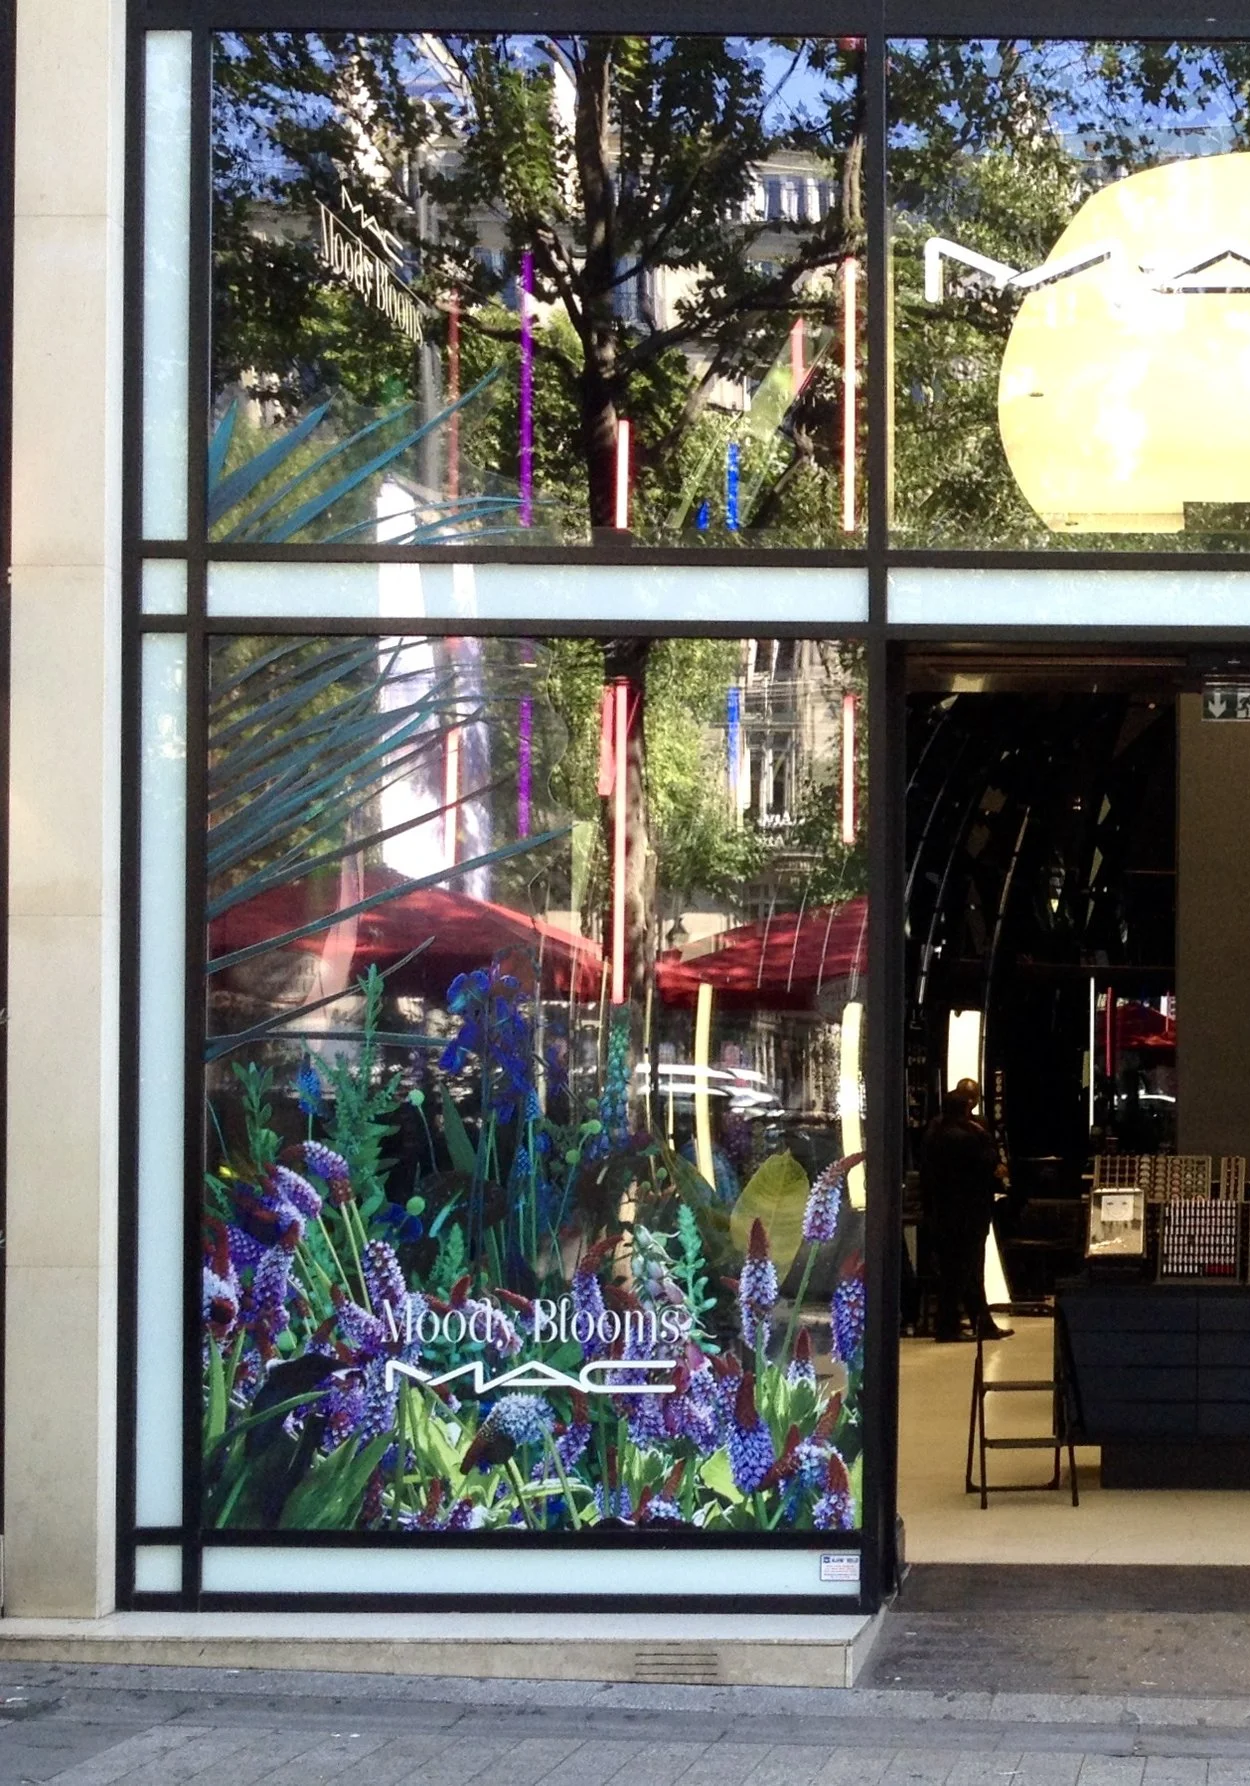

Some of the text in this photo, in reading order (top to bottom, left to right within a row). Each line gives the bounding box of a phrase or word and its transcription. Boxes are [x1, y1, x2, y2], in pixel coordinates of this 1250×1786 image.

[380, 1293, 686, 1349] Moody Blooms
[385, 1360, 677, 1394] MAC
